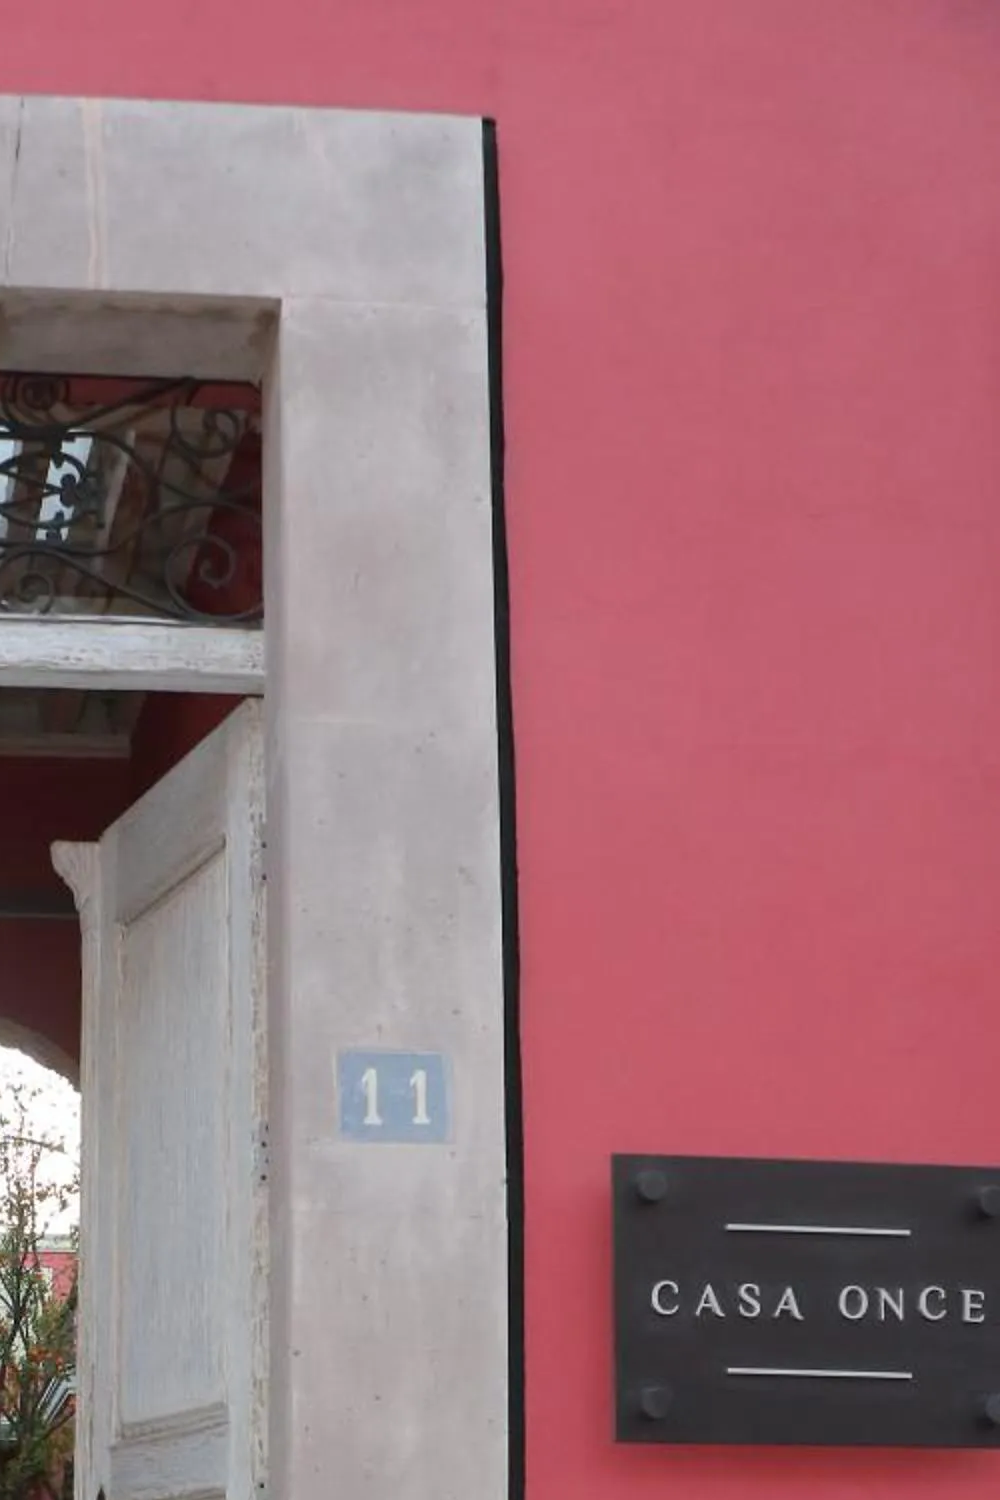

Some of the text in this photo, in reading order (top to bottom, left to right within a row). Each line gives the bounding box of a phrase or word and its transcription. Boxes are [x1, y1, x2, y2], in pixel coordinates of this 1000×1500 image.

[361, 1067, 431, 1125] 11
[651, 1280, 985, 1322] CASA ONCE
